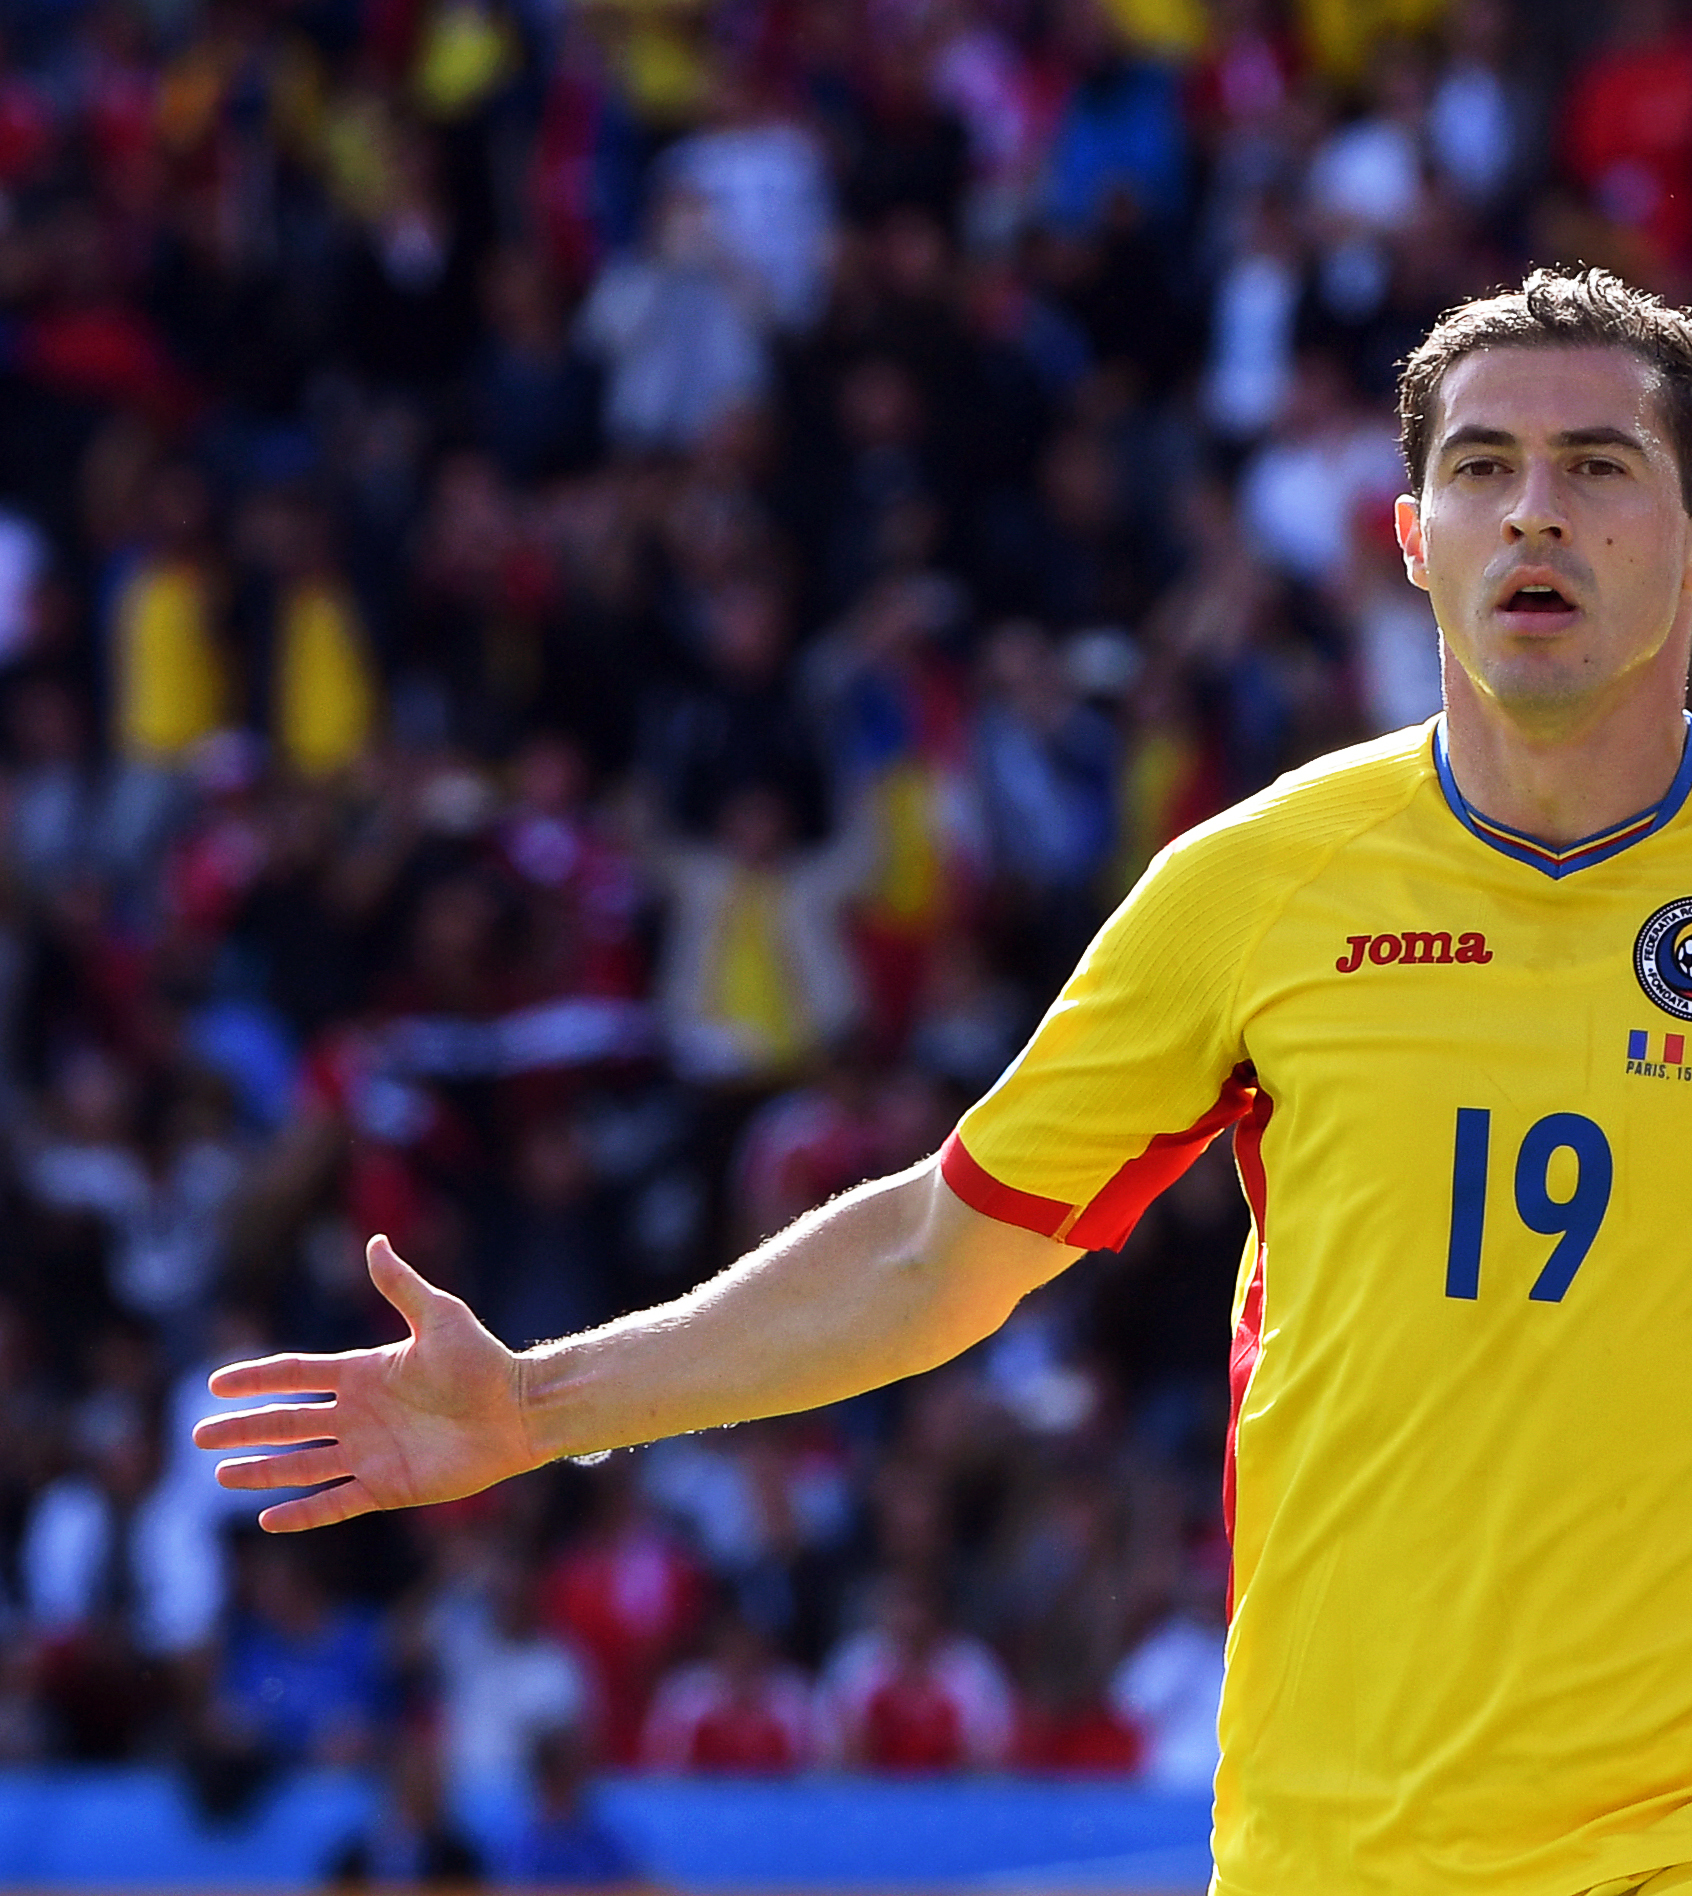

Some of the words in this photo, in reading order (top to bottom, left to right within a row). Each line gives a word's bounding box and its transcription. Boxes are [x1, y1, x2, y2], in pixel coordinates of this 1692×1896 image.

[1643, 911, 1681, 962] FEDERATIA
[1647, 970, 1690, 1011] FONDATA
[1625, 1060, 1671, 1081] PARIS,
[1445, 1107, 1613, 1303] 19
